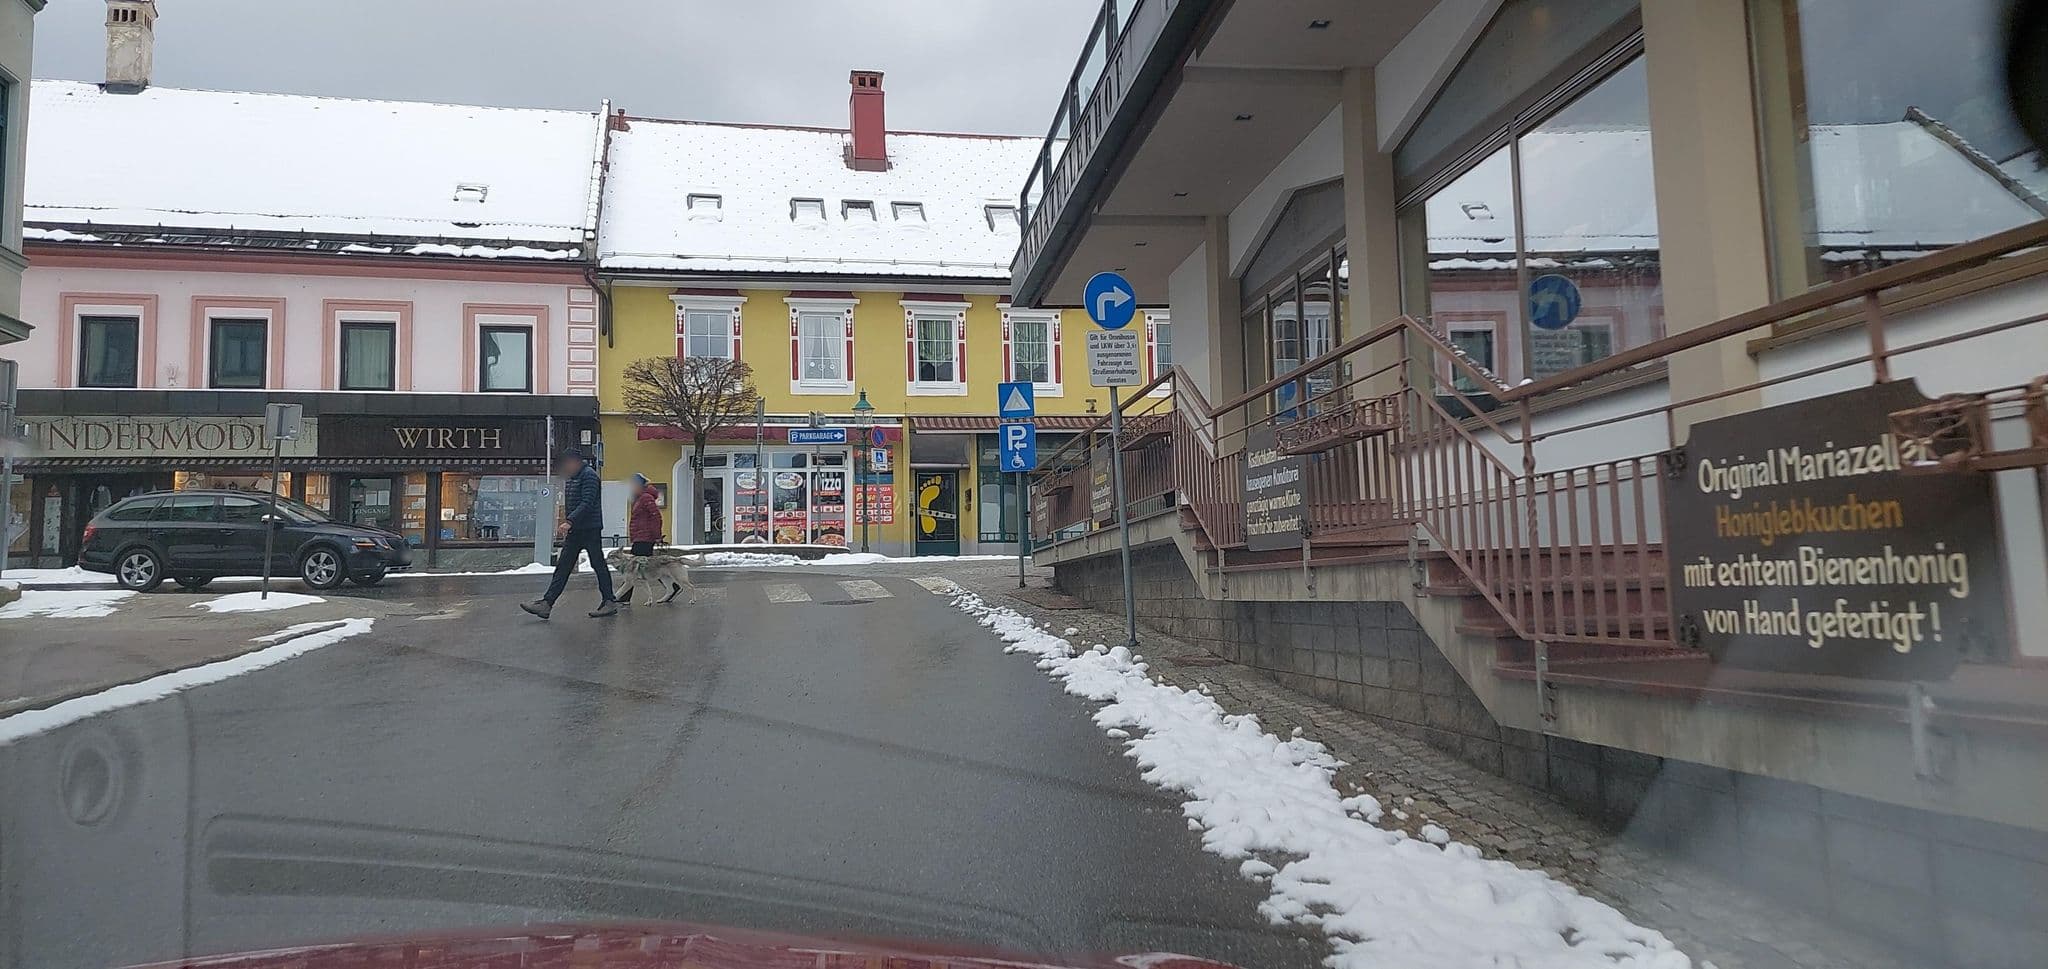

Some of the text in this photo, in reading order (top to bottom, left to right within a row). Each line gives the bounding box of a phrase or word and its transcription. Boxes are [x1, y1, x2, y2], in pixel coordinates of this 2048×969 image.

[393, 426, 502, 449] WIRTH
[799, 432, 834, 440] PARKGARAGE
[1007, 425, 1027, 451] P
[1698, 449, 1778, 499] Original
[1716, 493, 1904, 546] Honiglebkuchen
[1684, 542, 1969, 598] mit echtem Bienenhonig
[1704, 609, 1740, 635] von
[1744, 598, 1800, 636] Hand
[1806, 599, 1926, 653] gefertigt
